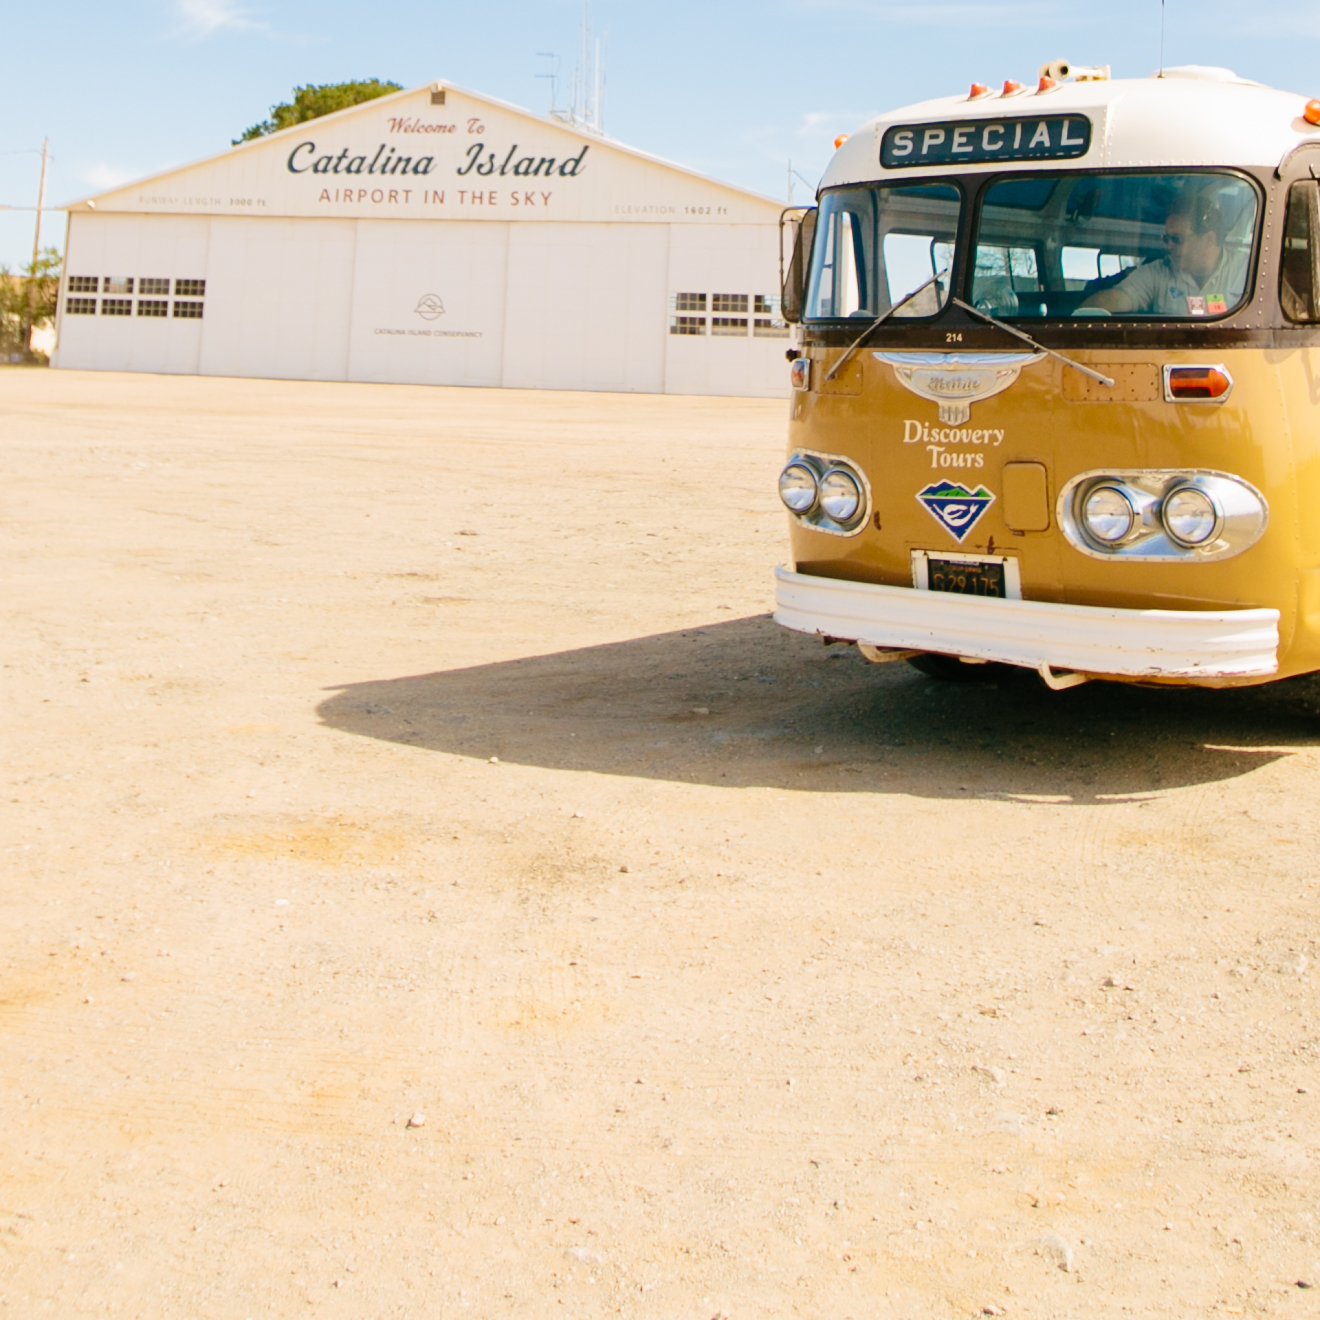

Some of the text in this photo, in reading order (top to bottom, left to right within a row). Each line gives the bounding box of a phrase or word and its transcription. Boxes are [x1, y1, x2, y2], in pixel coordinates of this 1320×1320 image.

[387, 117, 485, 135] Welcome To
[891, 119, 1084, 156] SPECIAL
[287, 141, 590, 178] Catalina Island
[183, 197, 221, 206] LENGTH
[228, 198, 253, 207] 3000
[257, 198, 267, 207] ft
[319, 188, 553, 207] AIRPORT IN THE SKY
[614, 205, 728, 215] ELEVATION 1602 ft
[374, 328, 483, 338] CATALINA ISLAND CONSERVANCY
[946, 333, 963, 342] 214
[902, 419, 1005, 446] Discovery
[926, 445, 984, 469] Tours
